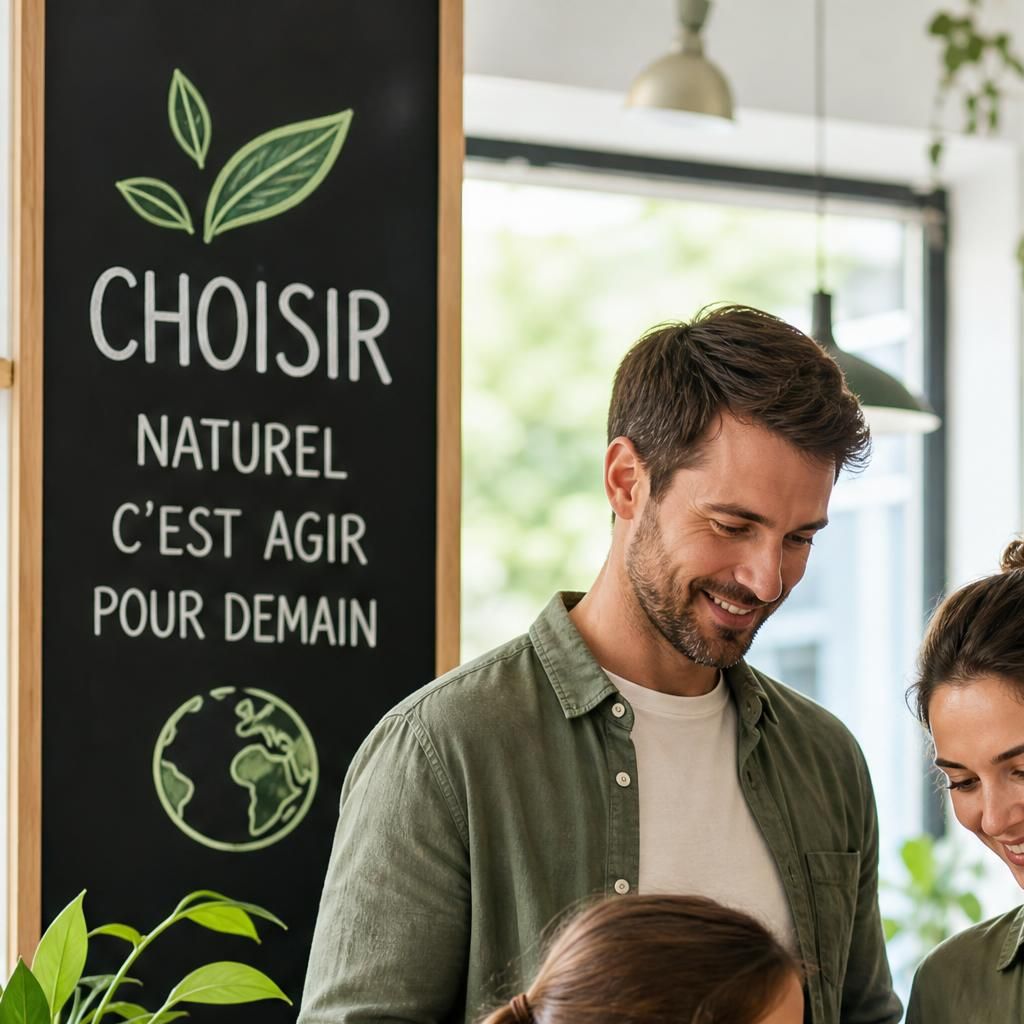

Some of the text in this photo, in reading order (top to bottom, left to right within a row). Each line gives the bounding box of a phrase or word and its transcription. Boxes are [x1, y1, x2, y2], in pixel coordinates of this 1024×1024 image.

[89, 266, 393, 386] CHOISIR
[137, 413, 348, 480] NATUREL
[112, 500, 368, 566] C'EST AGIR
[93, 585, 377, 648] POUR DEMAIN
